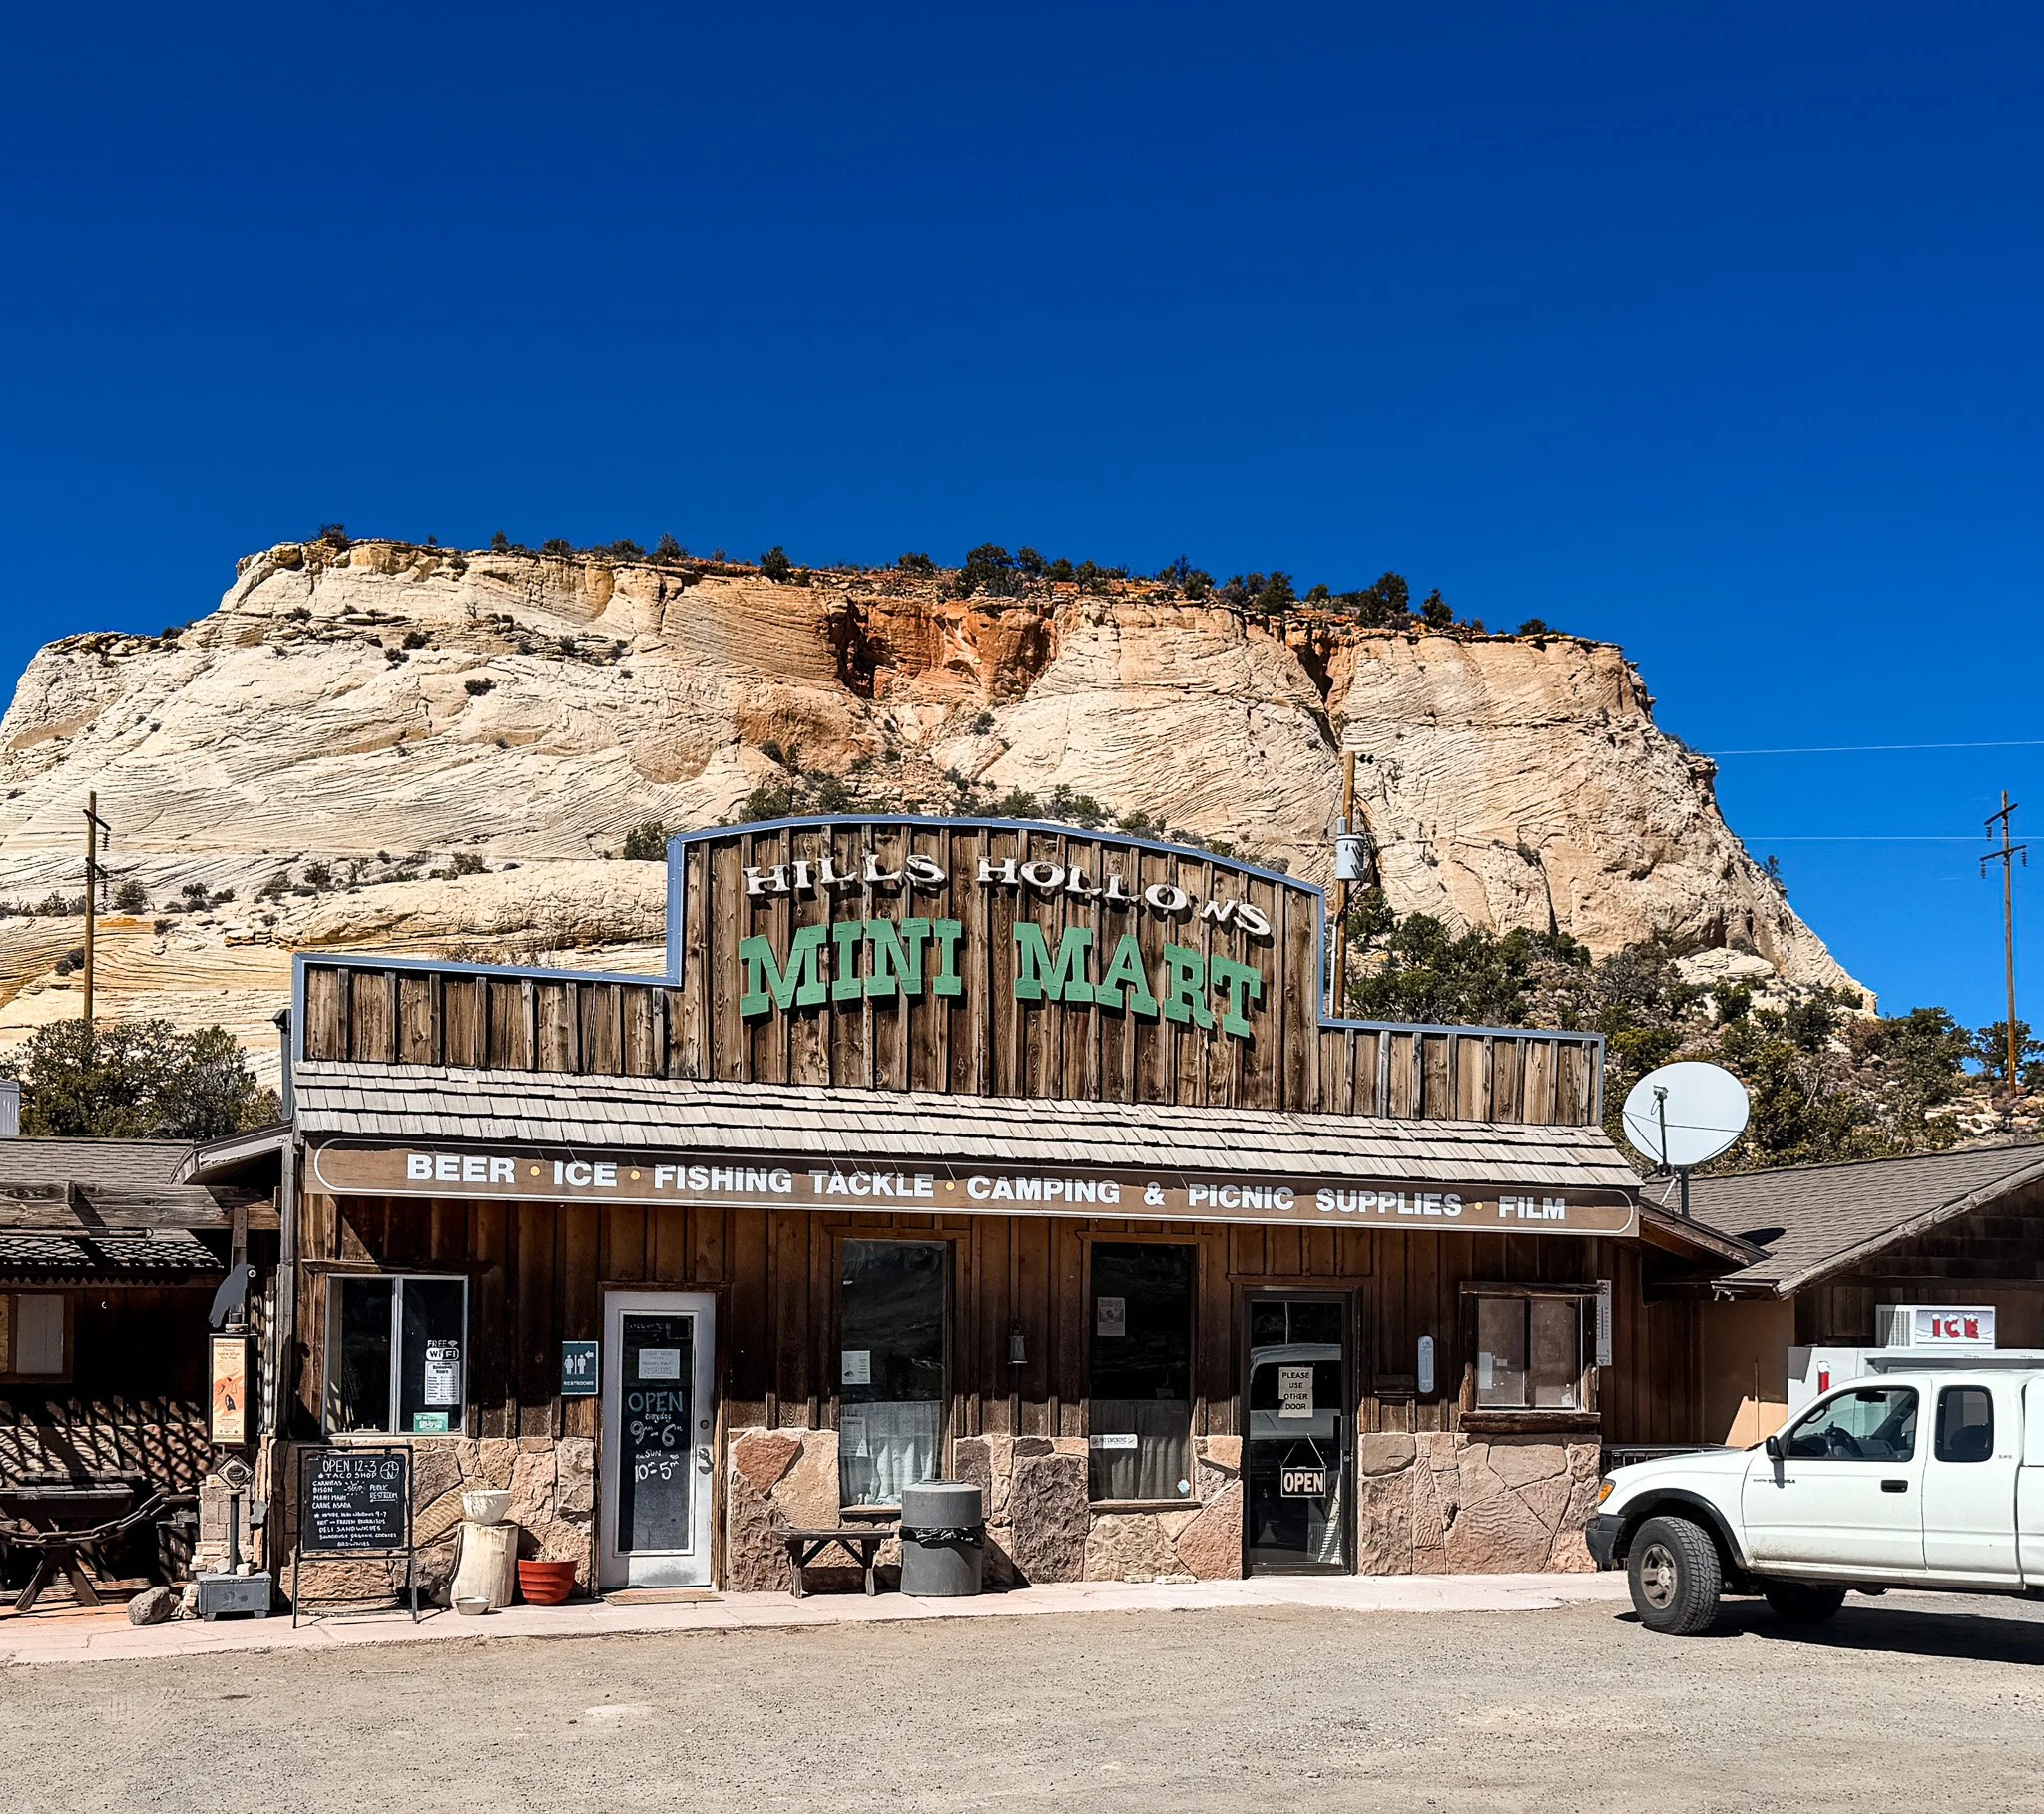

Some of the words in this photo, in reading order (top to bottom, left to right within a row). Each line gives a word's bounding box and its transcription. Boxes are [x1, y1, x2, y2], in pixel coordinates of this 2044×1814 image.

[743, 853, 947, 896] HILLS
[740, 918, 962, 1017] MINI
[1014, 922, 1262, 1039] MART
[407, 1153, 516, 1184] BEER
[553, 1160, 618, 1187] ICE
[654, 1164, 792, 1193] FISHING
[808, 1169, 934, 1198] TACKLE
[966, 1175, 1120, 1204] CAMPING
[1143, 1181, 1166, 1207] &
[1188, 1183, 1295, 1211] PICNIC
[1315, 1188, 1463, 1217] SUPPLIES
[1498, 1195, 1566, 1220] FILM
[1931, 1314, 1979, 1339] ICE
[628, 1390, 684, 1413] OPEN
[323, 1460, 350, 1473] OPEN
[354, 1460, 377, 1473] 12-3
[1283, 1472, 1324, 1493] OPEN
